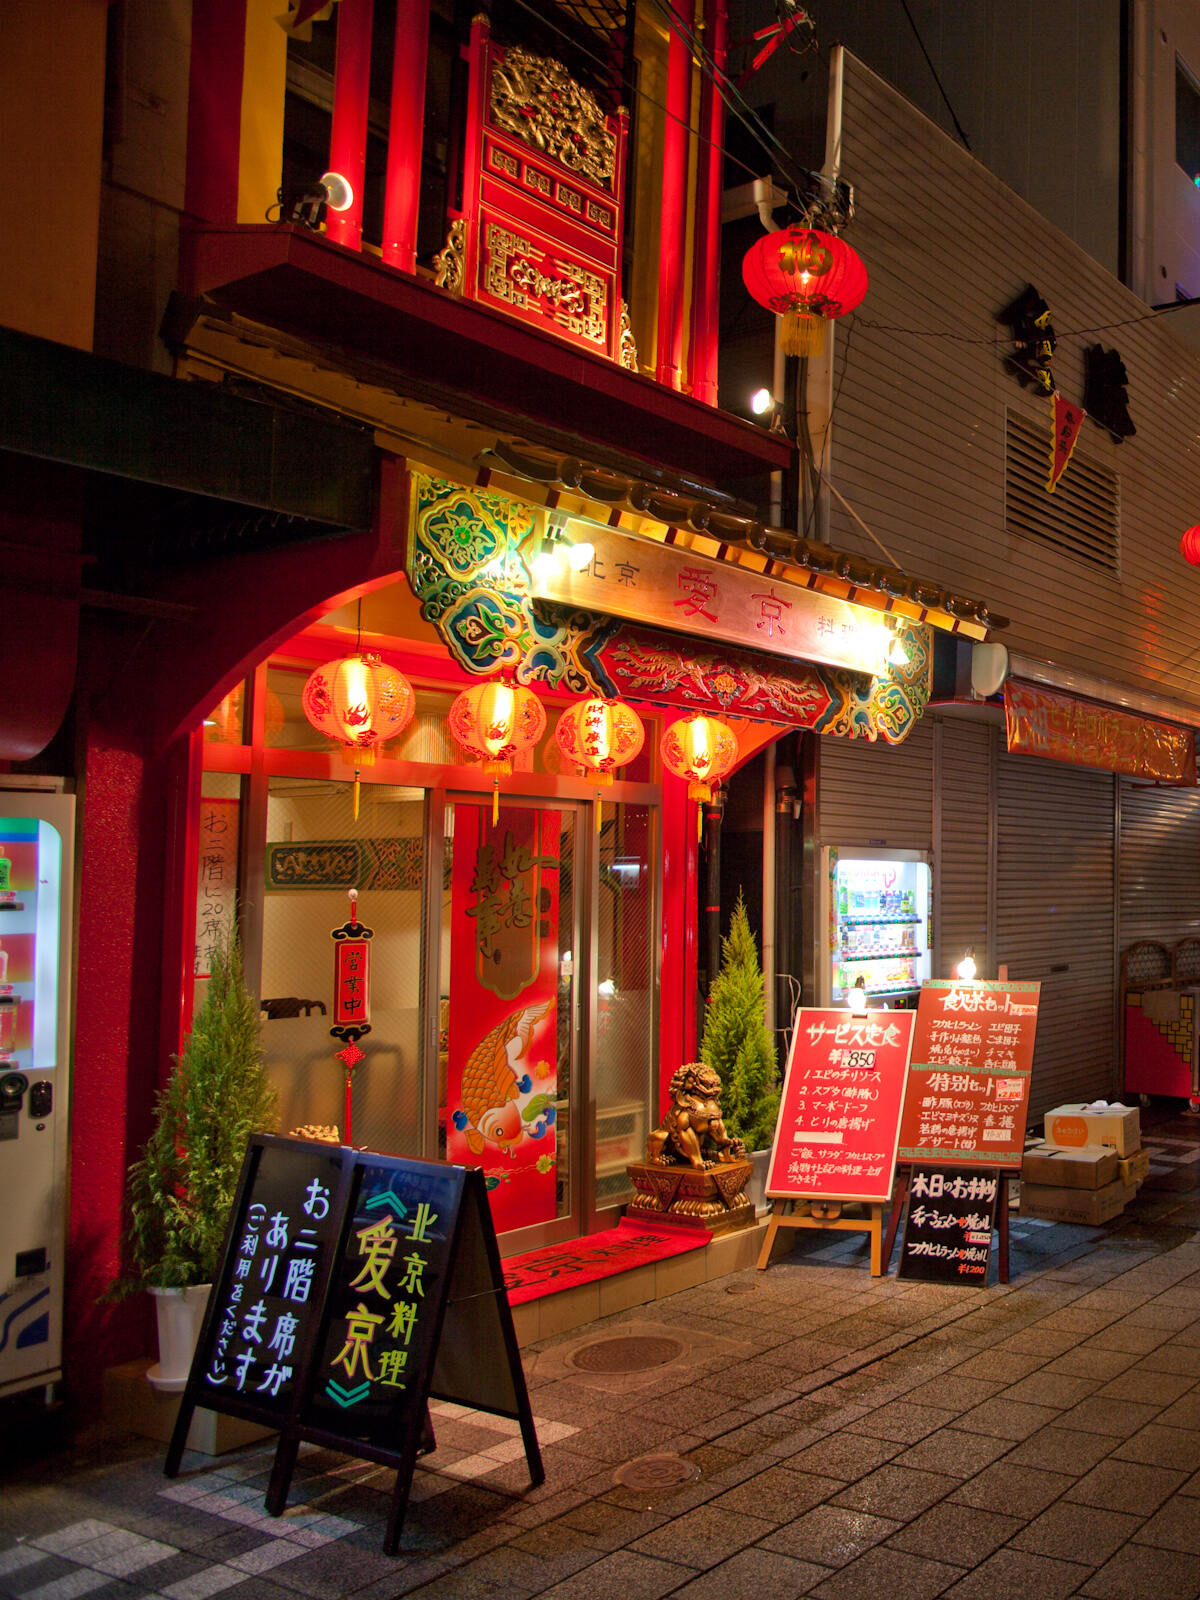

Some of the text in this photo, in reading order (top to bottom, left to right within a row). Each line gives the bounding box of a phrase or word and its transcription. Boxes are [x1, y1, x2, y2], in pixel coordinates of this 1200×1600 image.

[578, 549, 641, 588] 北京
[673, 566, 793, 638] 愛京
[806, 1020, 902, 1047] サービス定食
[926, 1072, 995, 1097] 特別セット
[236, 1211, 290, 1391] あります
[256, 1177, 331, 1397] お二階席が
[374, 1203, 438, 1390] 北京料理
